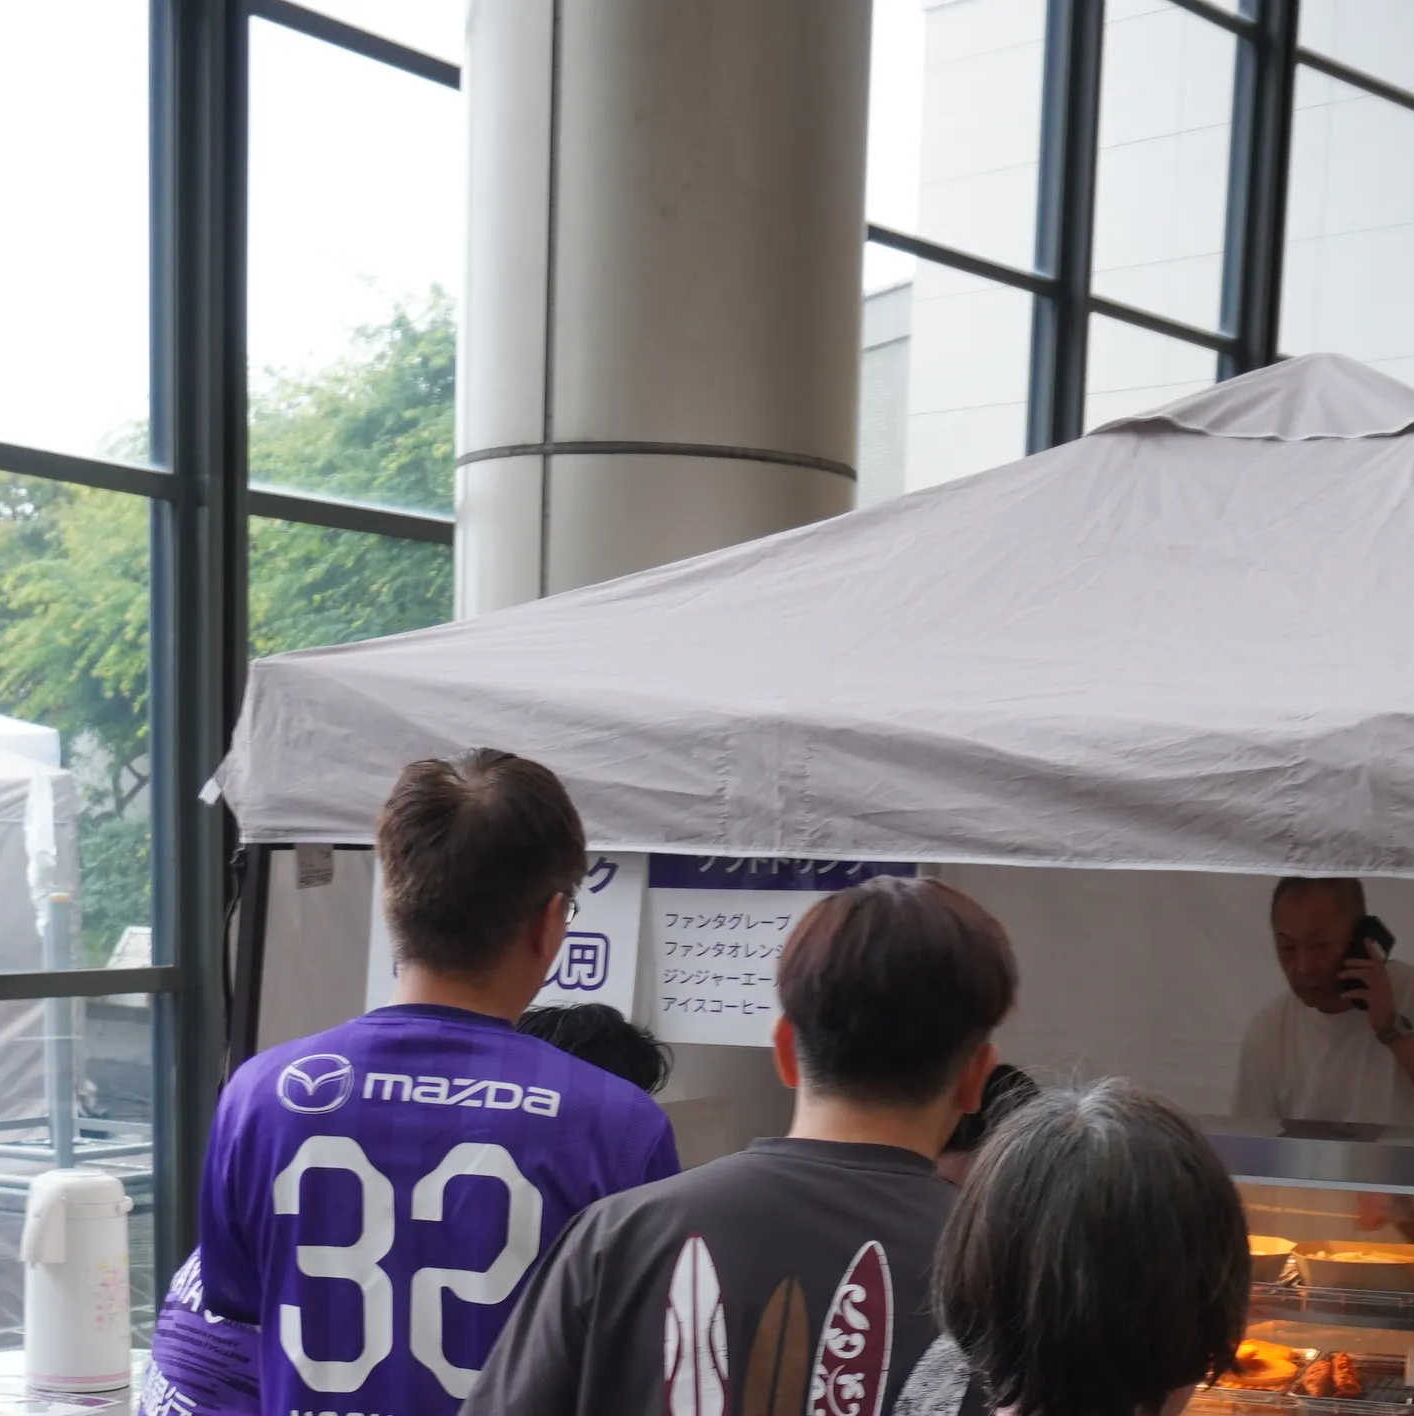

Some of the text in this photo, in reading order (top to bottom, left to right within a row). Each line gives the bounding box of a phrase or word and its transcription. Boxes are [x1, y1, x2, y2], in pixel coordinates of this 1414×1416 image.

[664, 913, 792, 931] ファンタグレープ
[662, 968, 782, 988] ジンジャーエー
[662, 996, 771, 1015] アイスコーヒー
[361, 1071, 563, 1119] mazda
[272, 1134, 544, 1401] 32
